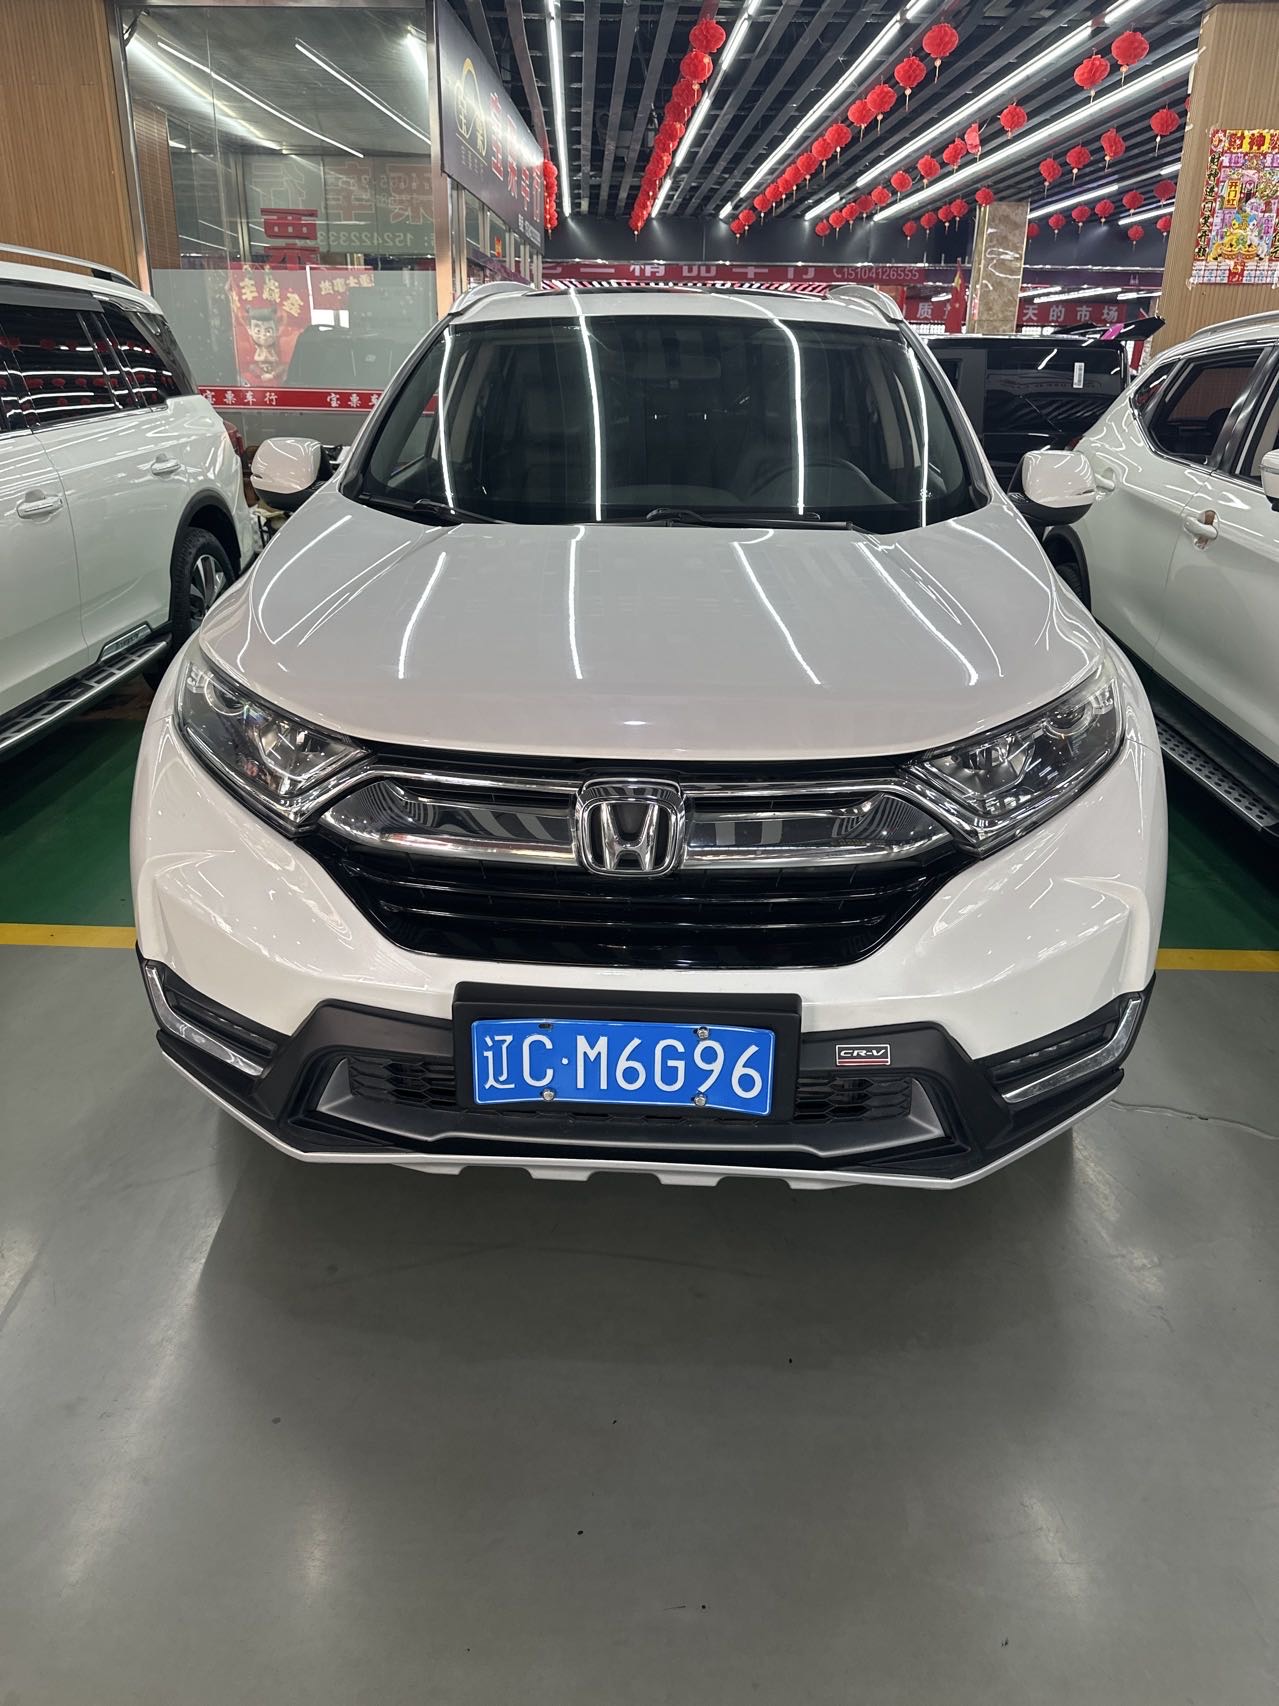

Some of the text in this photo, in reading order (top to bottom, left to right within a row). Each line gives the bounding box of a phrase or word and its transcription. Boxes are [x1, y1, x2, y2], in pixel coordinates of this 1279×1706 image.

[843, 267, 919, 280] 15104126555
[1022, 304, 1119, 321] 天的市场
[840, 1049, 886, 1057] CR-V
